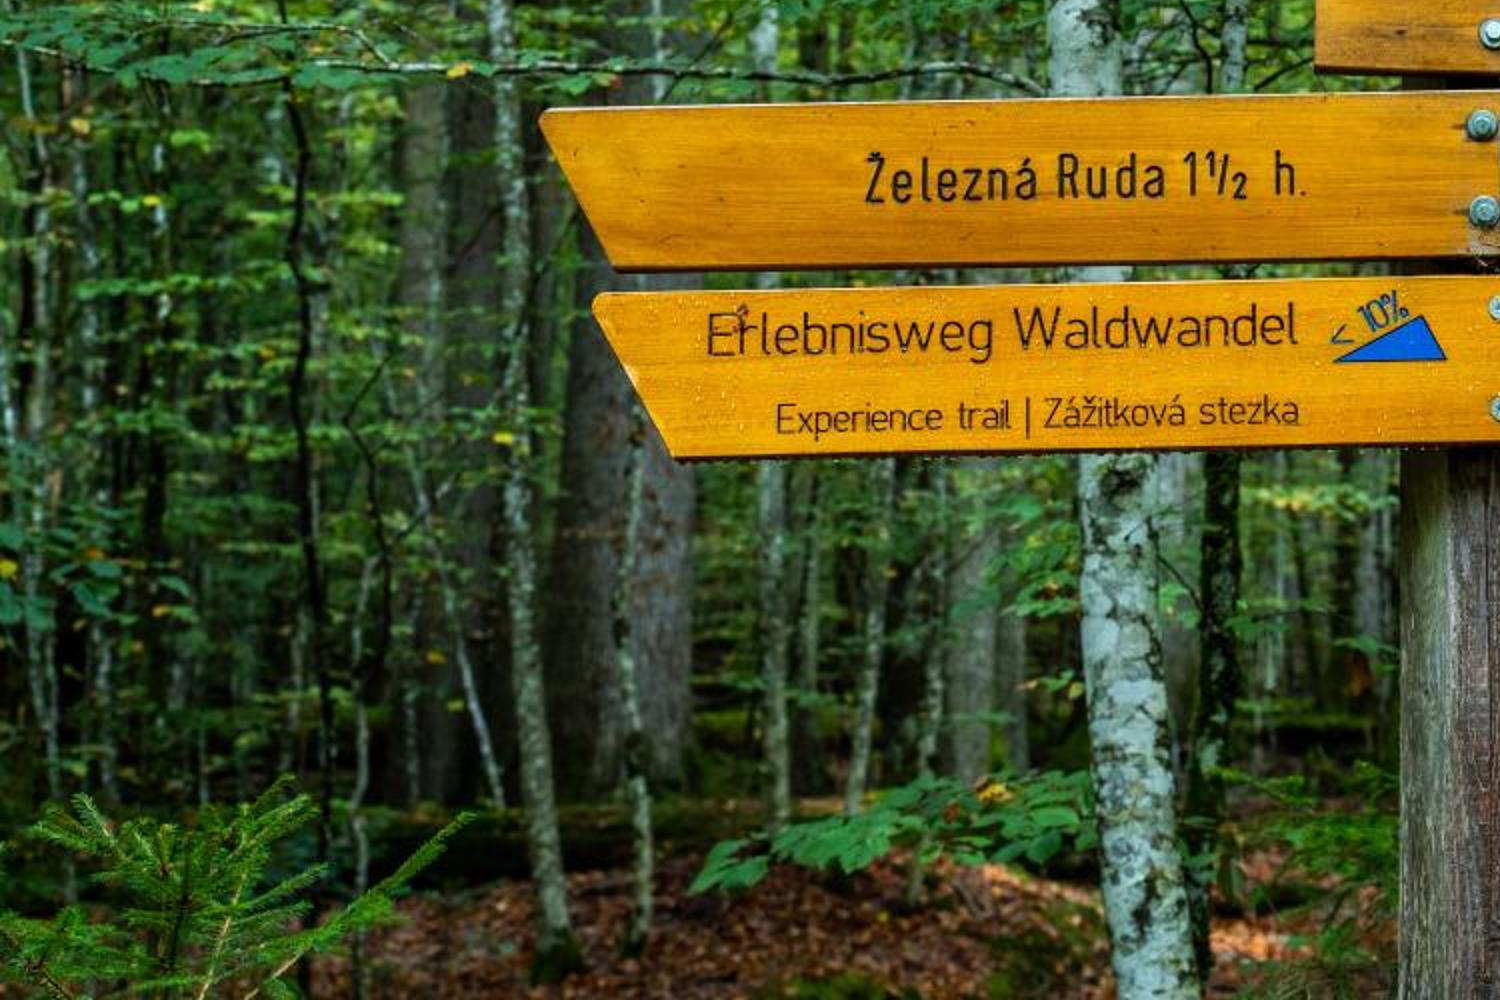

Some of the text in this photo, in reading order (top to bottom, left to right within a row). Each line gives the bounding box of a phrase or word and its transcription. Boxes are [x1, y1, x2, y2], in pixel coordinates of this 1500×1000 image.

[865, 151, 1039, 205] Železná
[1056, 151, 1165, 200] Ruda
[1274, 149, 1307, 198] h.
[706, 301, 1299, 365] Erlebnisweg Waldwandel
[1356, 288, 1410, 332] 10%
[775, 401, 943, 443] Experience
[958, 398, 1012, 431] trail
[1043, 394, 1187, 430] Zážitková
[1199, 394, 1300, 427] stezka
